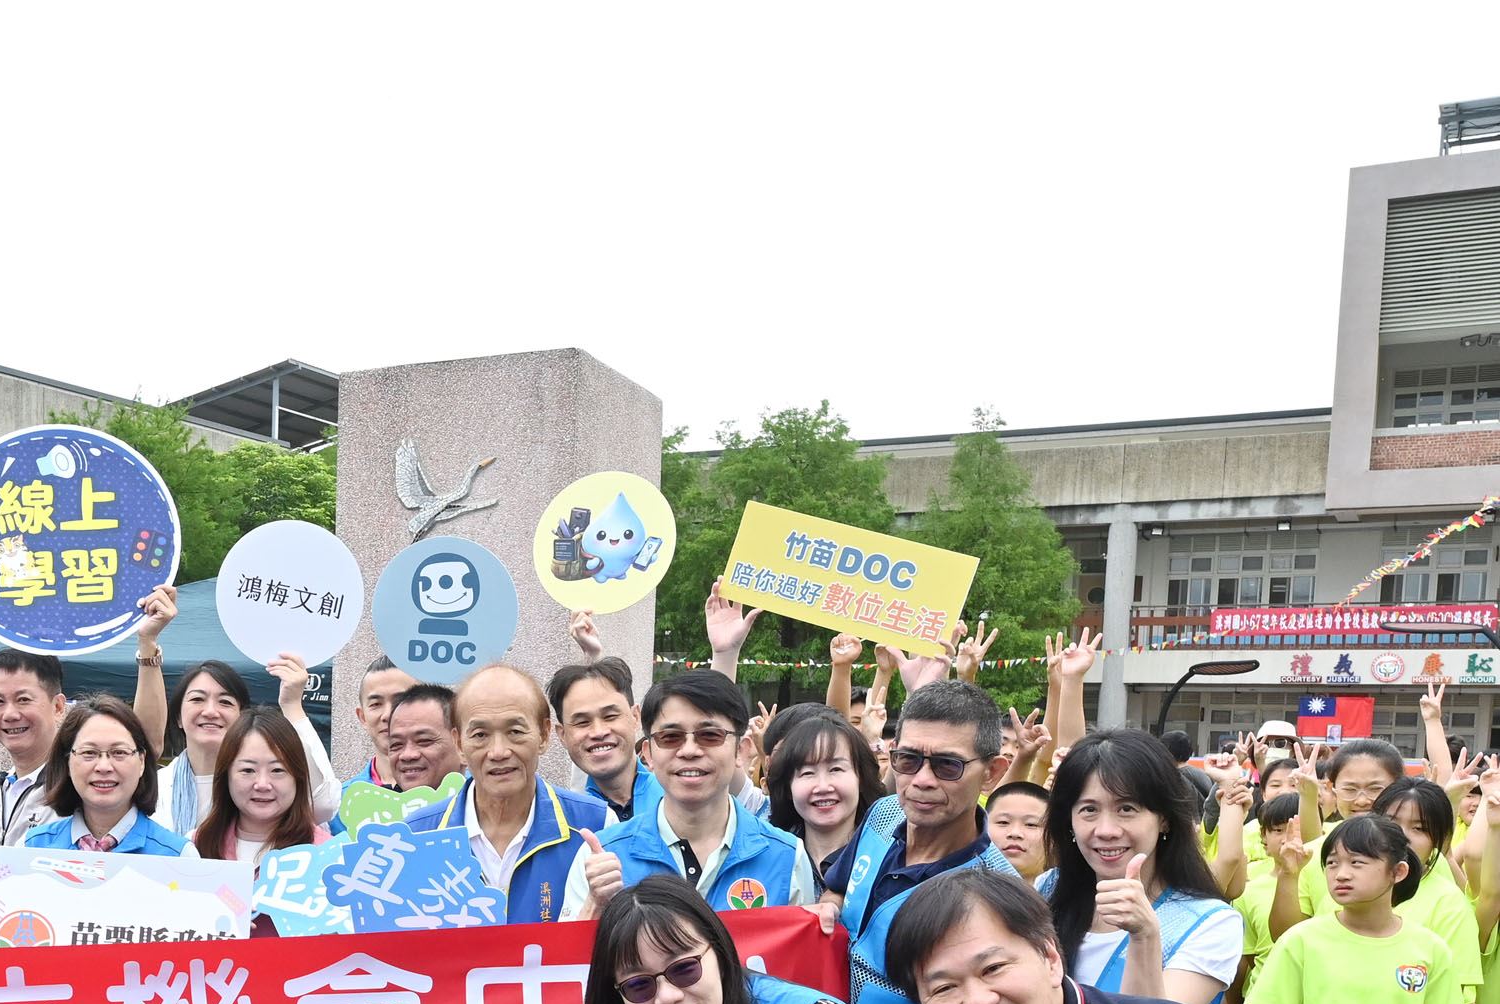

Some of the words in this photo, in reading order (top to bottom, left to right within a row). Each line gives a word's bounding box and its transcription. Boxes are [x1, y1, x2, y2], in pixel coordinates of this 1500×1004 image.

[784, 530, 917, 591] 竹苗DOC
[237, 573, 345, 620] 鴻梅文創
[407, 639, 477, 665] DOC
[1290, 652, 1313, 676] 禮
[1333, 653, 1354, 677] 義
